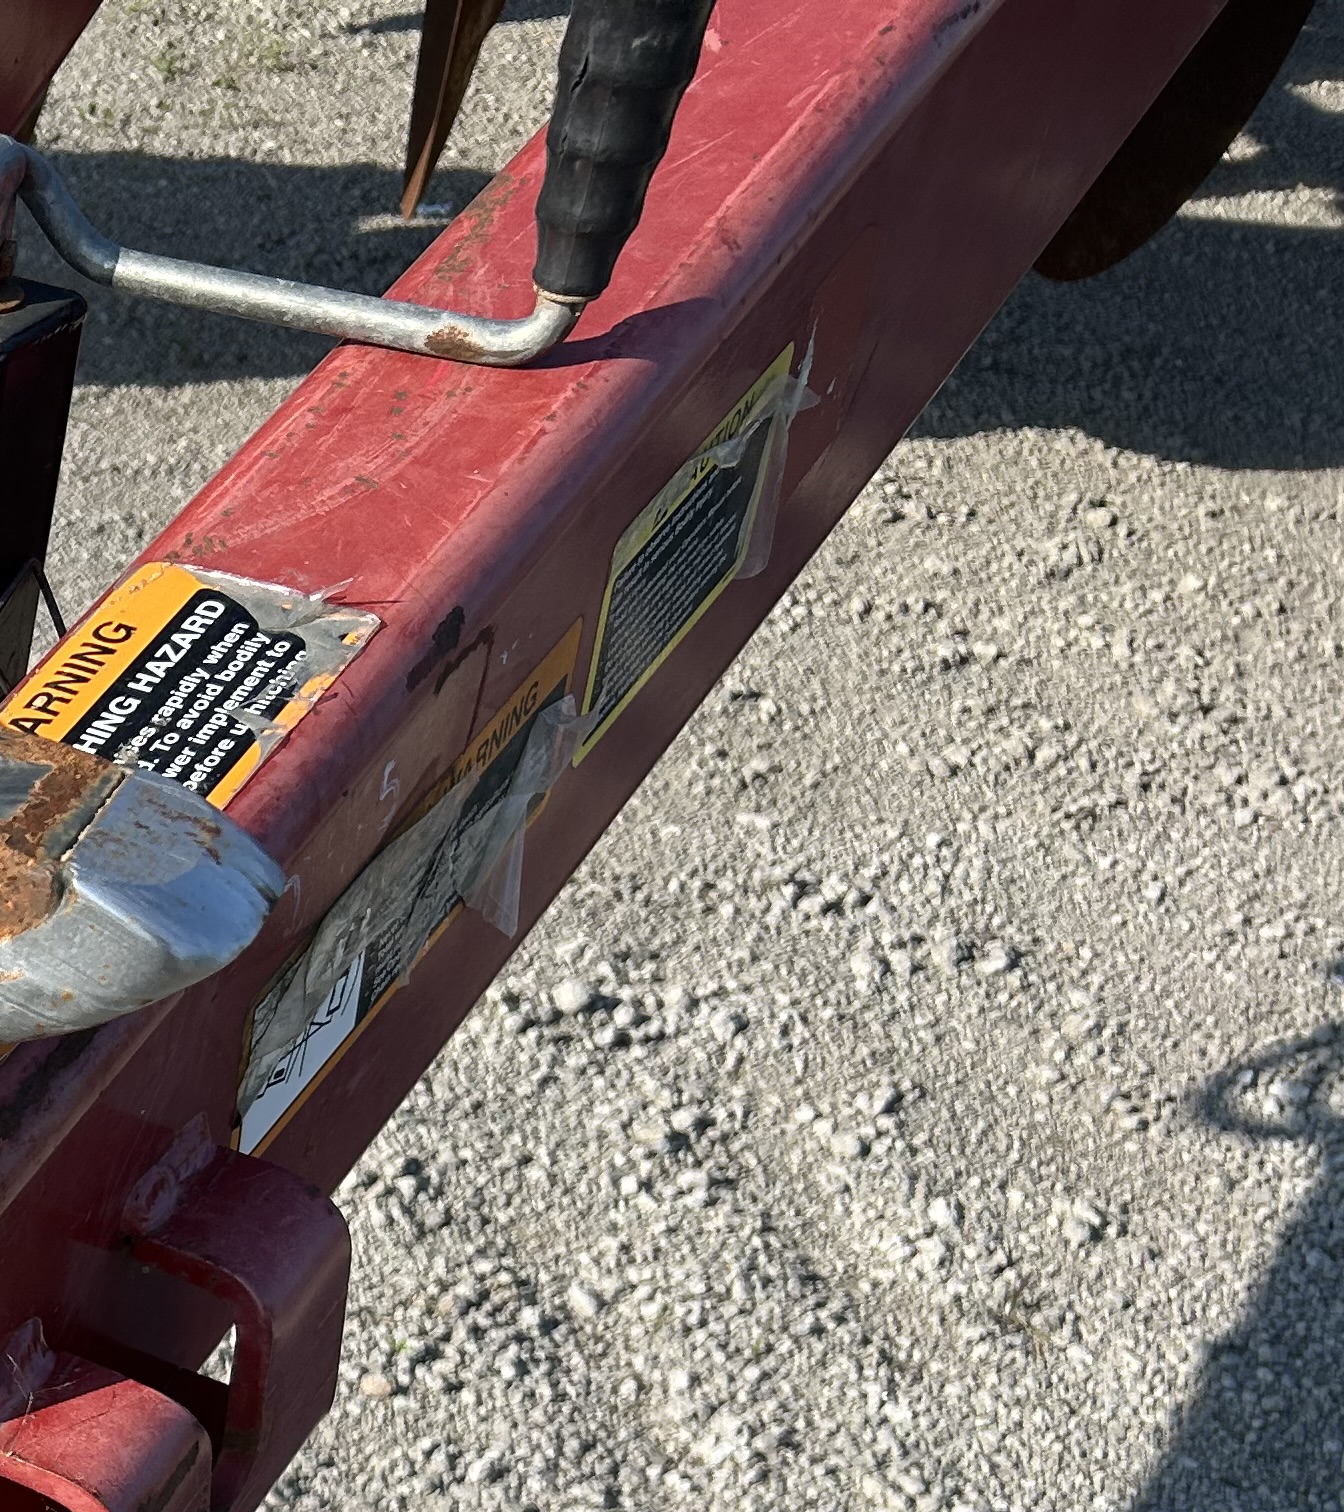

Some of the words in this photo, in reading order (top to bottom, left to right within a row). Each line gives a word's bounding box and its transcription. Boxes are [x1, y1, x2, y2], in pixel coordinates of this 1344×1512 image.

[8, 621, 138, 736] ARNING
[72, 696, 141, 754] HING
[127, 600, 225, 692] HAZARD
[149, 732, 180, 751] To
[176, 683, 224, 730] avoid
[214, 632, 271, 682] bodily
[150, 666, 210, 726] rapidly
[202, 622, 250, 664] when
[162, 746, 196, 777] wer
[187, 659, 276, 745] implement
[265, 641, 291, 658] to
